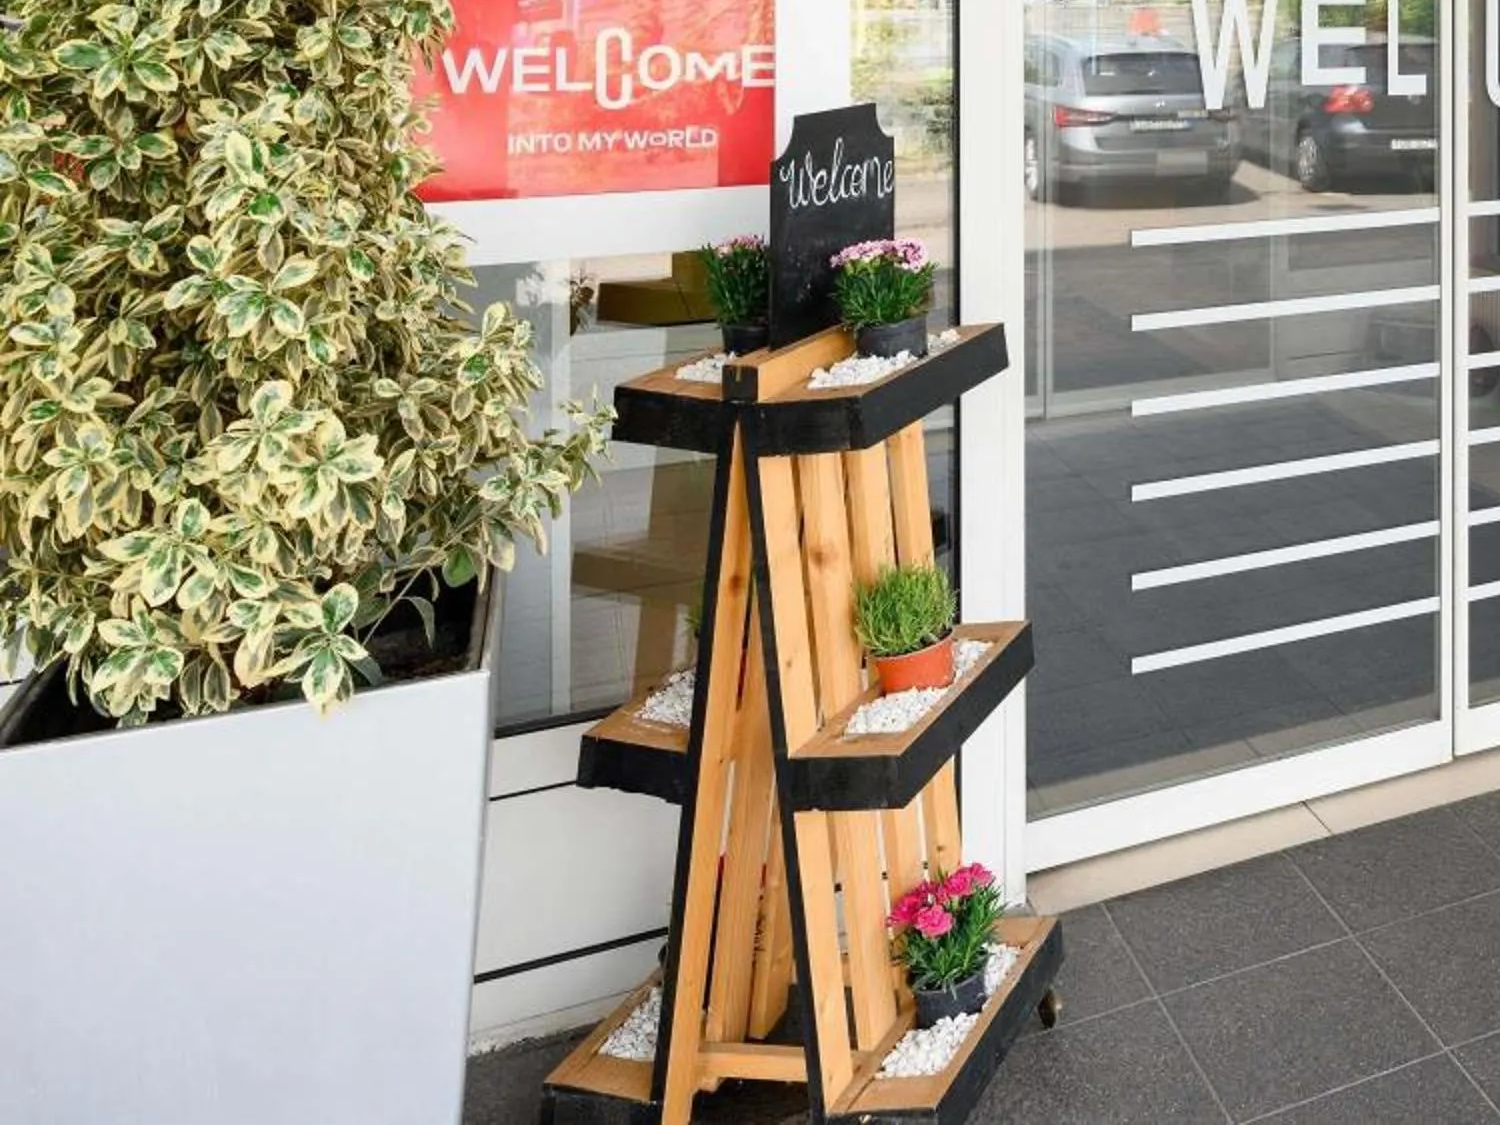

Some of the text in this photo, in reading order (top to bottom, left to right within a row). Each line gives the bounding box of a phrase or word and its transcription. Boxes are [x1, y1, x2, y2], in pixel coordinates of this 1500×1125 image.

[441, 26, 776, 110] WELCOME
[507, 126, 717, 155] INTO MY WORLD
[779, 136, 894, 209] Welcome
